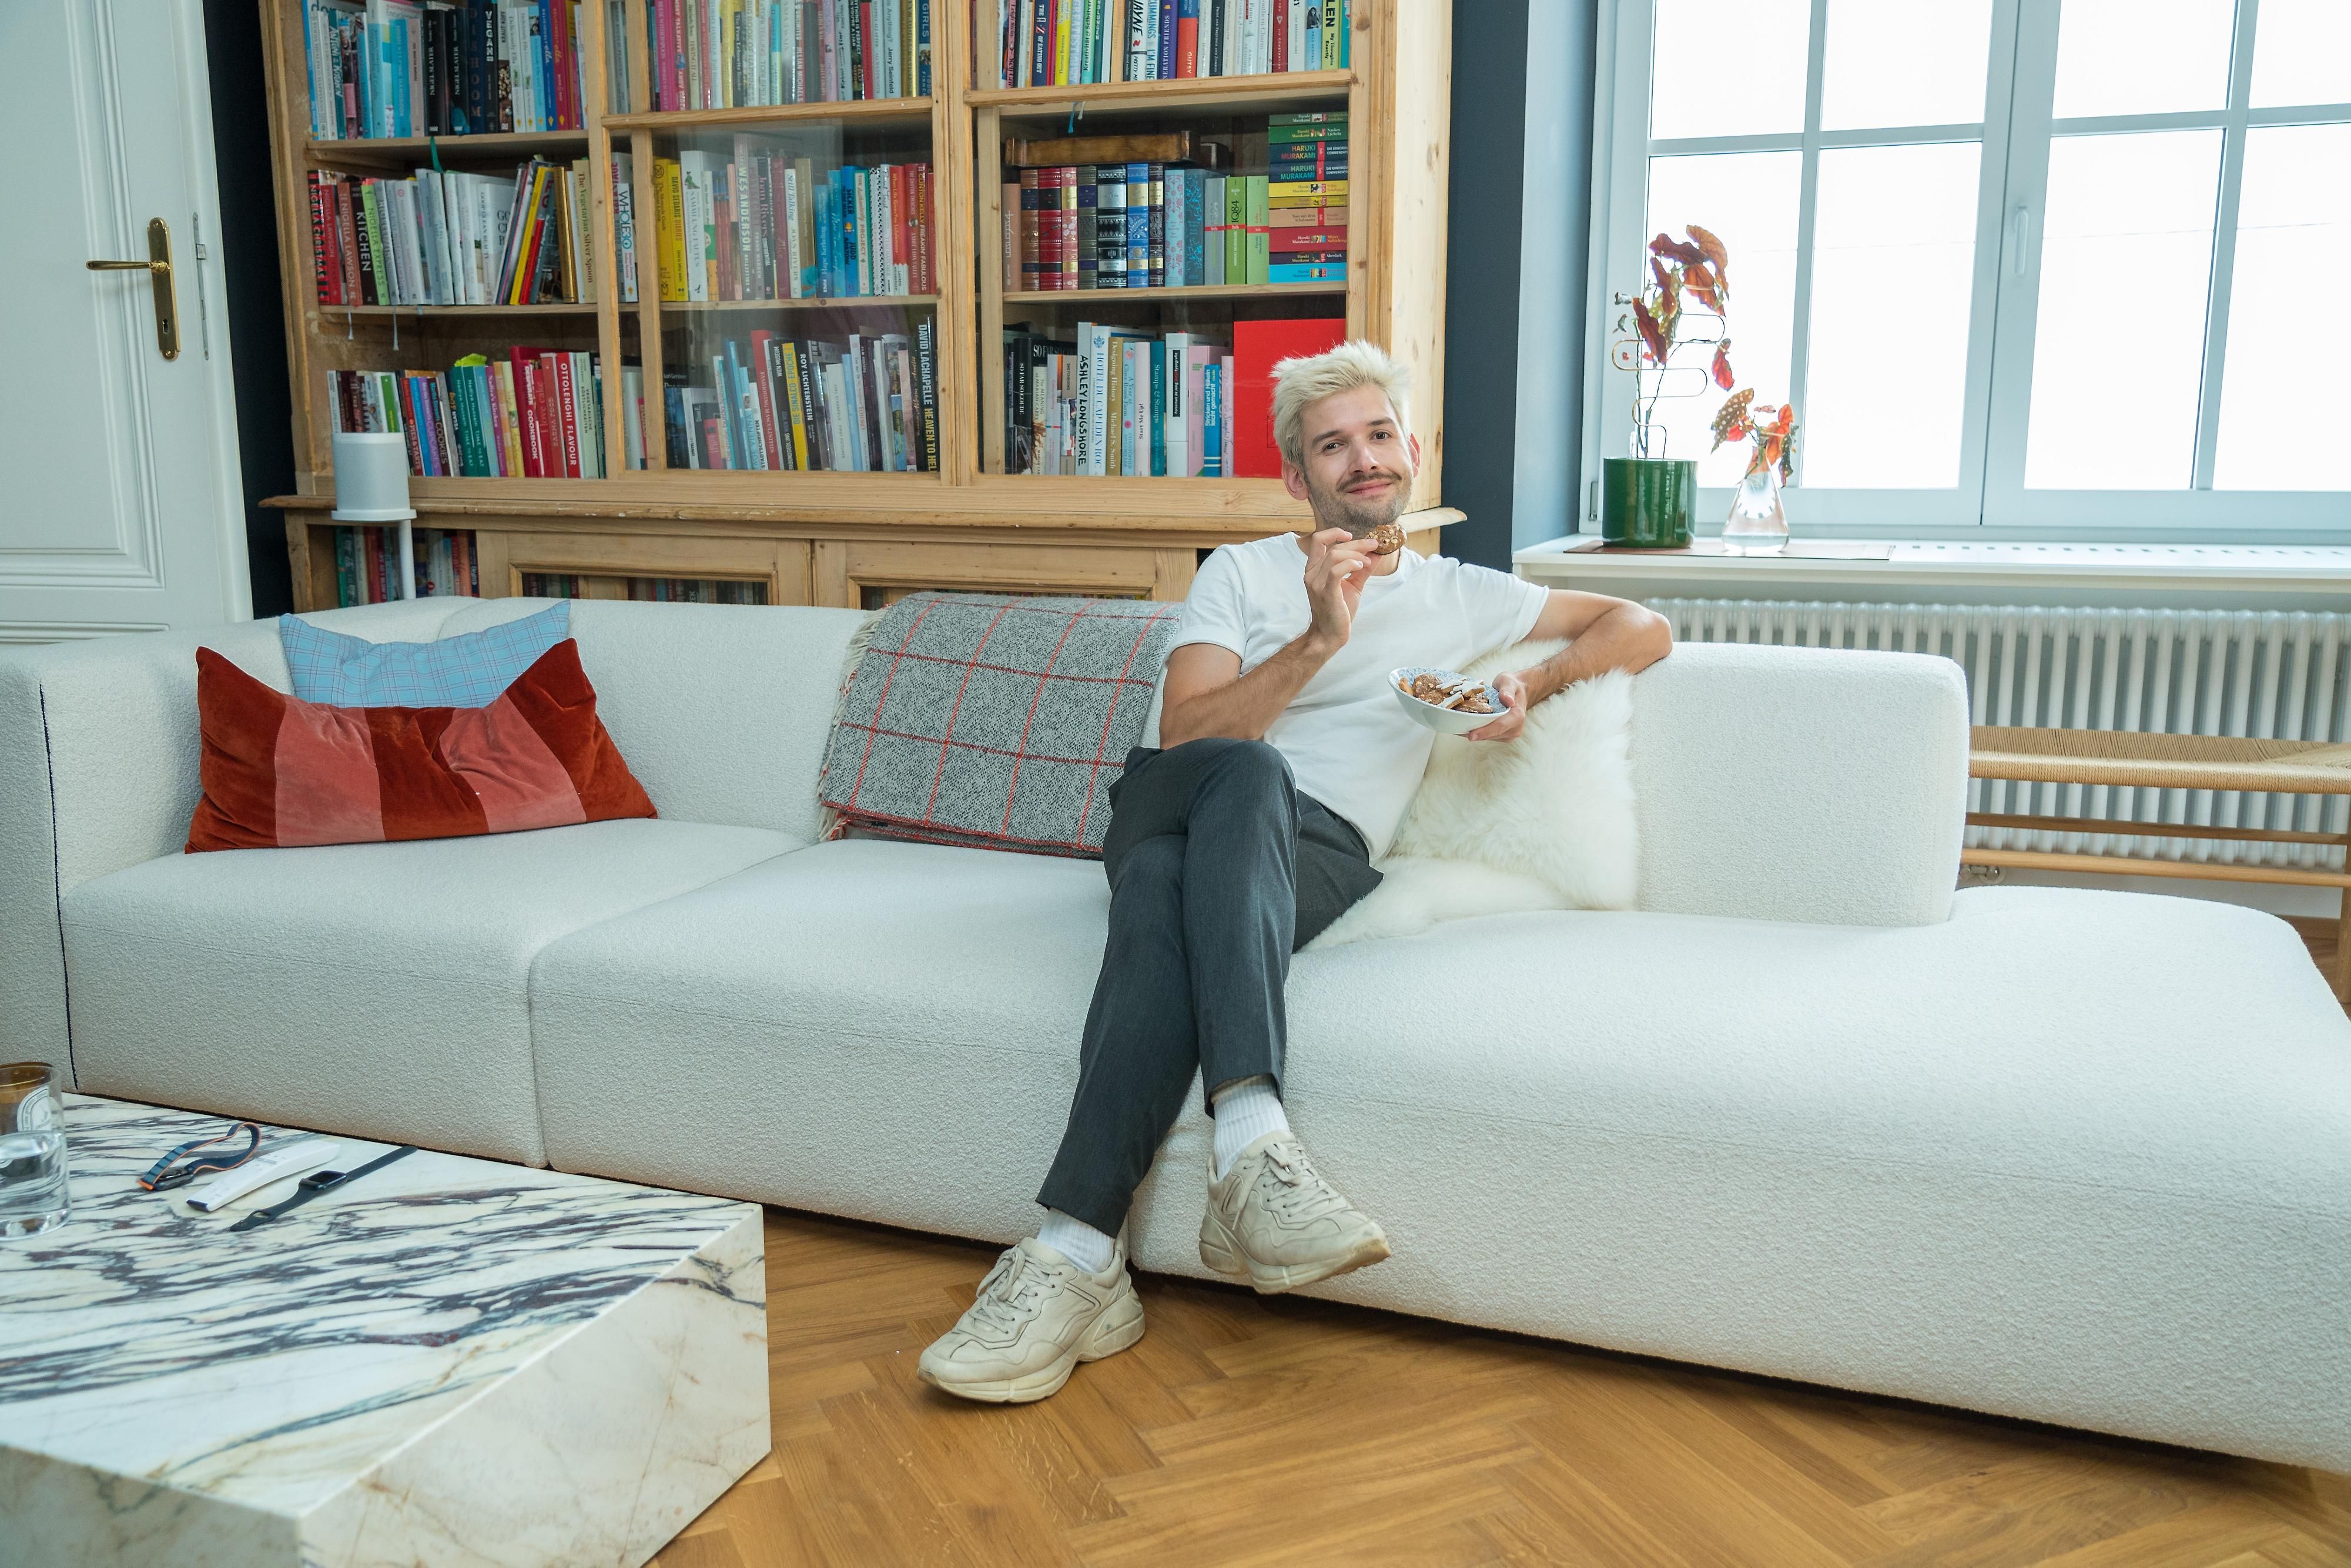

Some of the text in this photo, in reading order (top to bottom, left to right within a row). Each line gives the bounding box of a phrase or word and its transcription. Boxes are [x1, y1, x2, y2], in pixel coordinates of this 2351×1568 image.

[748, 42, 753, 52] OF
[1146, 49, 1156, 80] I'M FINE
[310, 184, 324, 278] NIGELLA CHRISTMAS
[580, 189, 590, 232] Vegetarian
[619, 190, 633, 249] WHOLE30
[675, 219, 683, 242] DIARIES
[738, 167, 751, 252] WES ANDERSON
[341, 202, 355, 287] NIGELLA LAWSON
[356, 212, 372, 272] KITCHEN
[367, 207, 384, 286] NIGELLA EXPRESS
[918, 324, 936, 454] DAVID LACHAPELLE HEAVEN TO
[1020, 363, 1025, 371] SO
[1020, 384, 1025, 393] SO
[1096, 385, 1104, 397] DU
[1110, 377, 1118, 401] History
[560, 362, 577, 466] OTTOLENGHI FLAVOUR
[802, 371, 813, 421] LICHTENSTEIN
[1078, 354, 1089, 466] ASHLEY LONGSHORE
[1138, 414, 1144, 423] Me
[426, 421, 438, 468] CUPCAKES
[436, 422, 447, 464] COOKIES
[528, 409, 538, 460] COOKBOOK
[746, 414, 754, 445] VIENNA
[755, 420, 766, 469] STADTSCHRIFTEN
